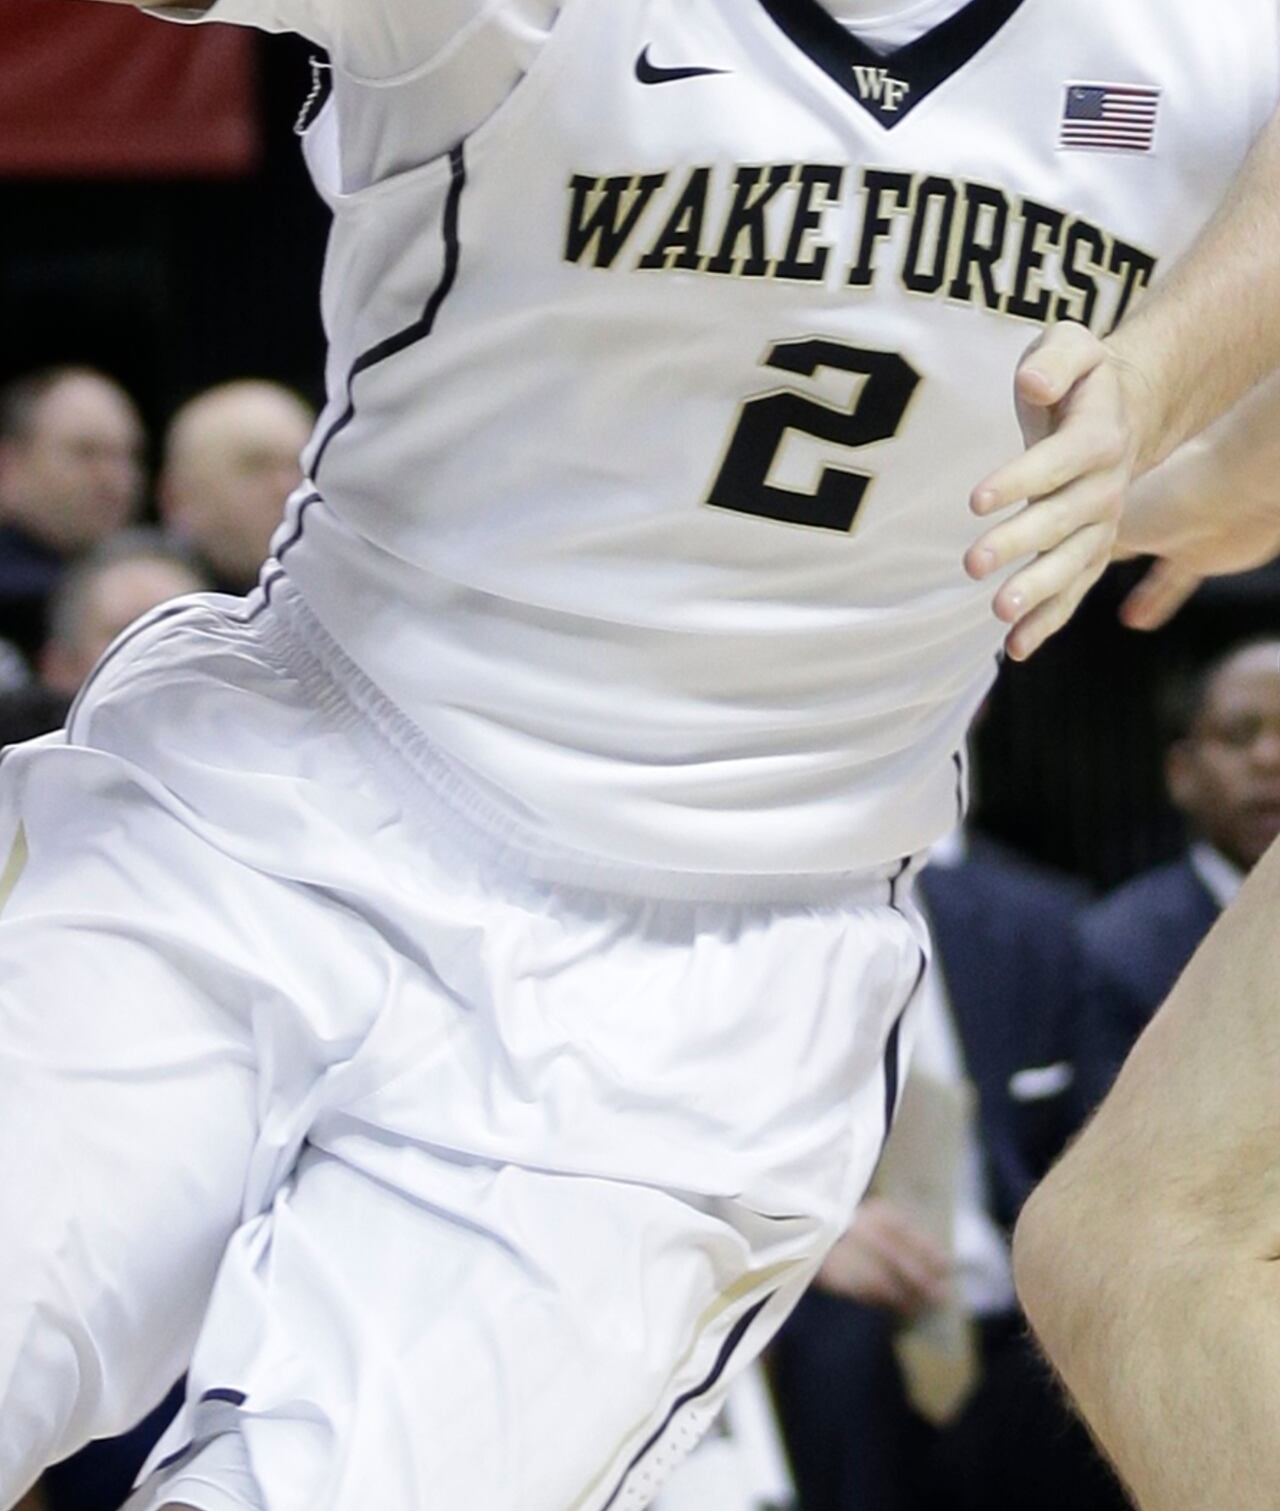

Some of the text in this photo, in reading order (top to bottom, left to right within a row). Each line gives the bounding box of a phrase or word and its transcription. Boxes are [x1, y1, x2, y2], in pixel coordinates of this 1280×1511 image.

[852, 64, 910, 112] WF
[562, 162, 1160, 338] WAKE FOREST
[698, 333, 925, 538] 2
